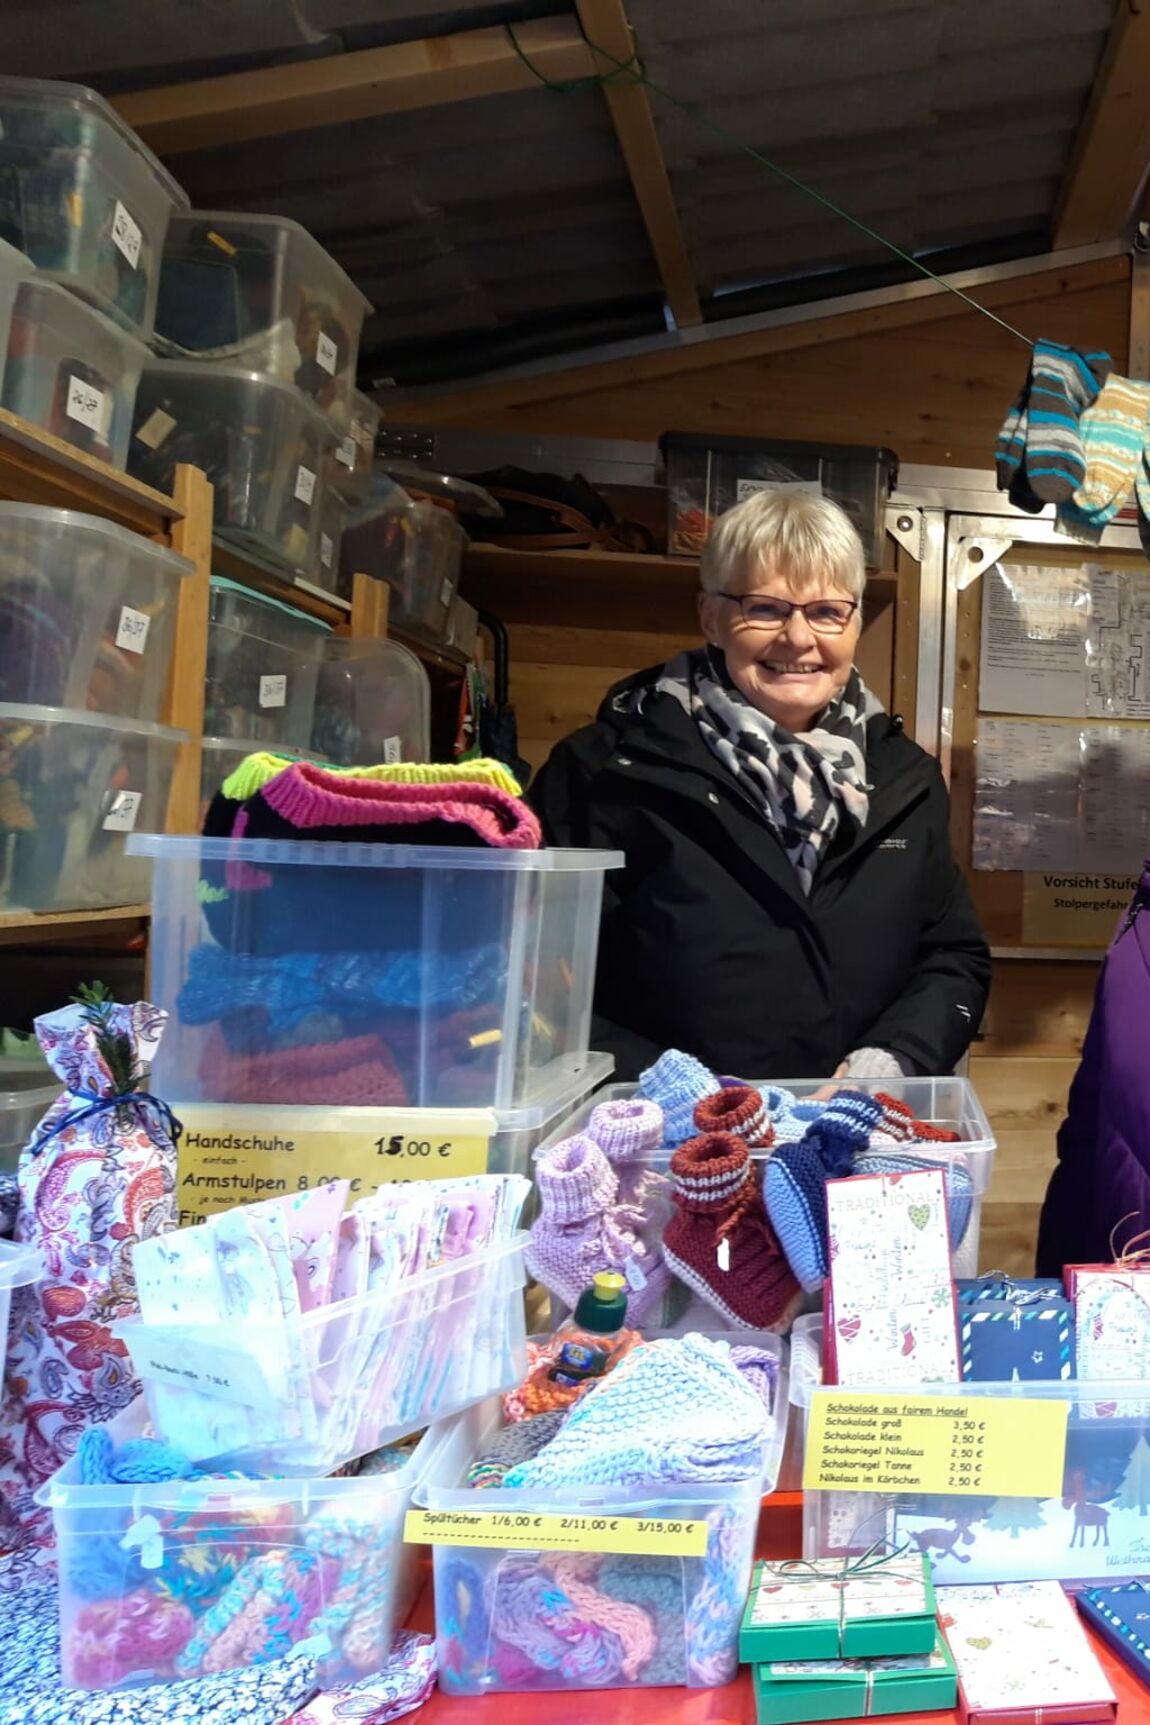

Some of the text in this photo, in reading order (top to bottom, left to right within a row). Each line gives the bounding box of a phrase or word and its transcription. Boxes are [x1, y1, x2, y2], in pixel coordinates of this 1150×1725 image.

[1043, 875, 1139, 890] Vorsicht Stufe
[1053, 898, 1129, 911] Stolpergefahr
[185, 1133, 452, 1158] Handschuhe 15,00 €
[182, 1173, 362, 1195] Armstulpen 80 €
[178, 1210, 208, 1226] Fin
[826, 1403, 968, 1417] Schokolade aus fairem Handel
[825, 1417, 986, 1432] Schokolade groß 3,50 €
[823, 1431, 984, 1445] Schokolade klein 2,50 €
[822, 1445, 983, 1458] Schokoriegel Nikolaus 2,50 €
[821, 1459, 982, 1472] Schokoriegel Tanne 2,50 €
[819, 1473, 859, 1483] Nikolaus
[863, 1475, 873, 1483] im
[948, 1476, 970, 1486] 2,50
[973, 1477, 981, 1486] €
[423, 1513, 695, 1534] Spültücher 1/6,00 € 2/11,00 € 3/15,00 €
